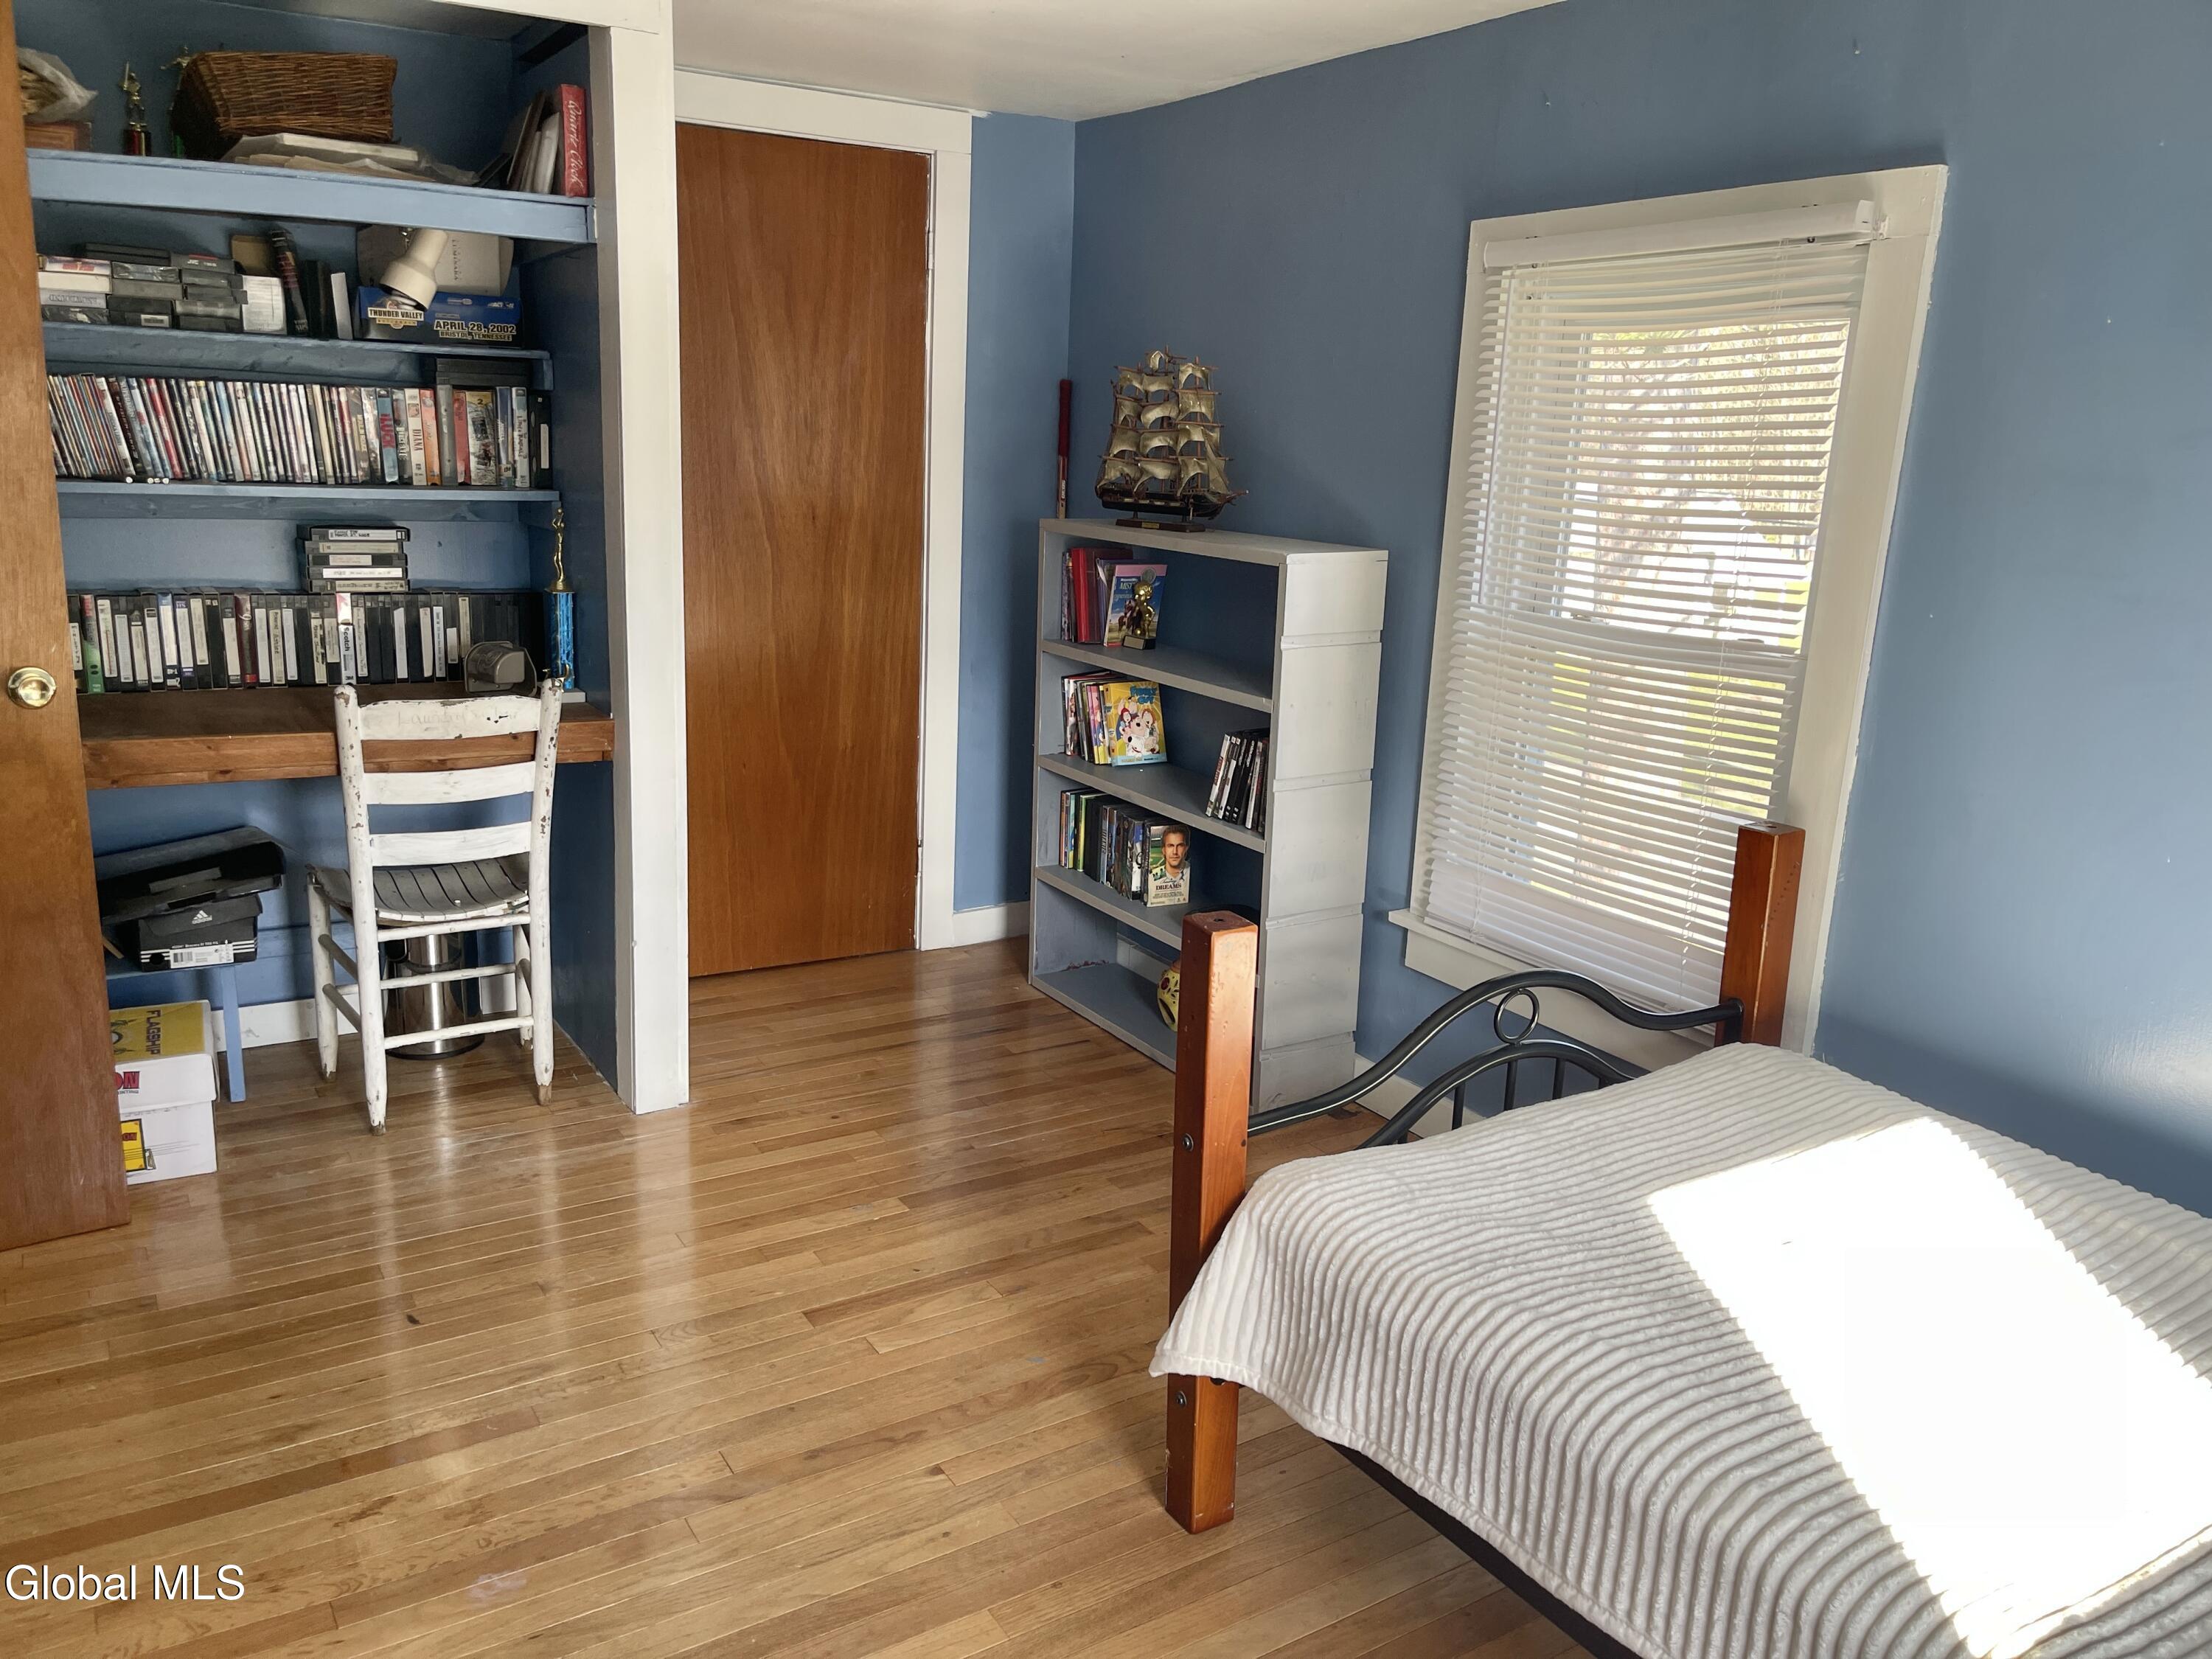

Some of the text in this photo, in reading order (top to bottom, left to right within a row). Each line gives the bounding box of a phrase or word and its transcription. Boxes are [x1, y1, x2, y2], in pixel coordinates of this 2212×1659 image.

[567, 100, 584, 187] Quartz Clock
[369, 309, 423, 319] THUNDER VALLEY
[435, 321, 515, 333] APRIL 28, 2002
[440, 331, 511, 341] BRISTOL, TENNESSEE
[412, 429, 423, 451] DIANA
[343, 627, 352, 651] Scotch
[146, 1009, 161, 1055] FLAGSHIP
